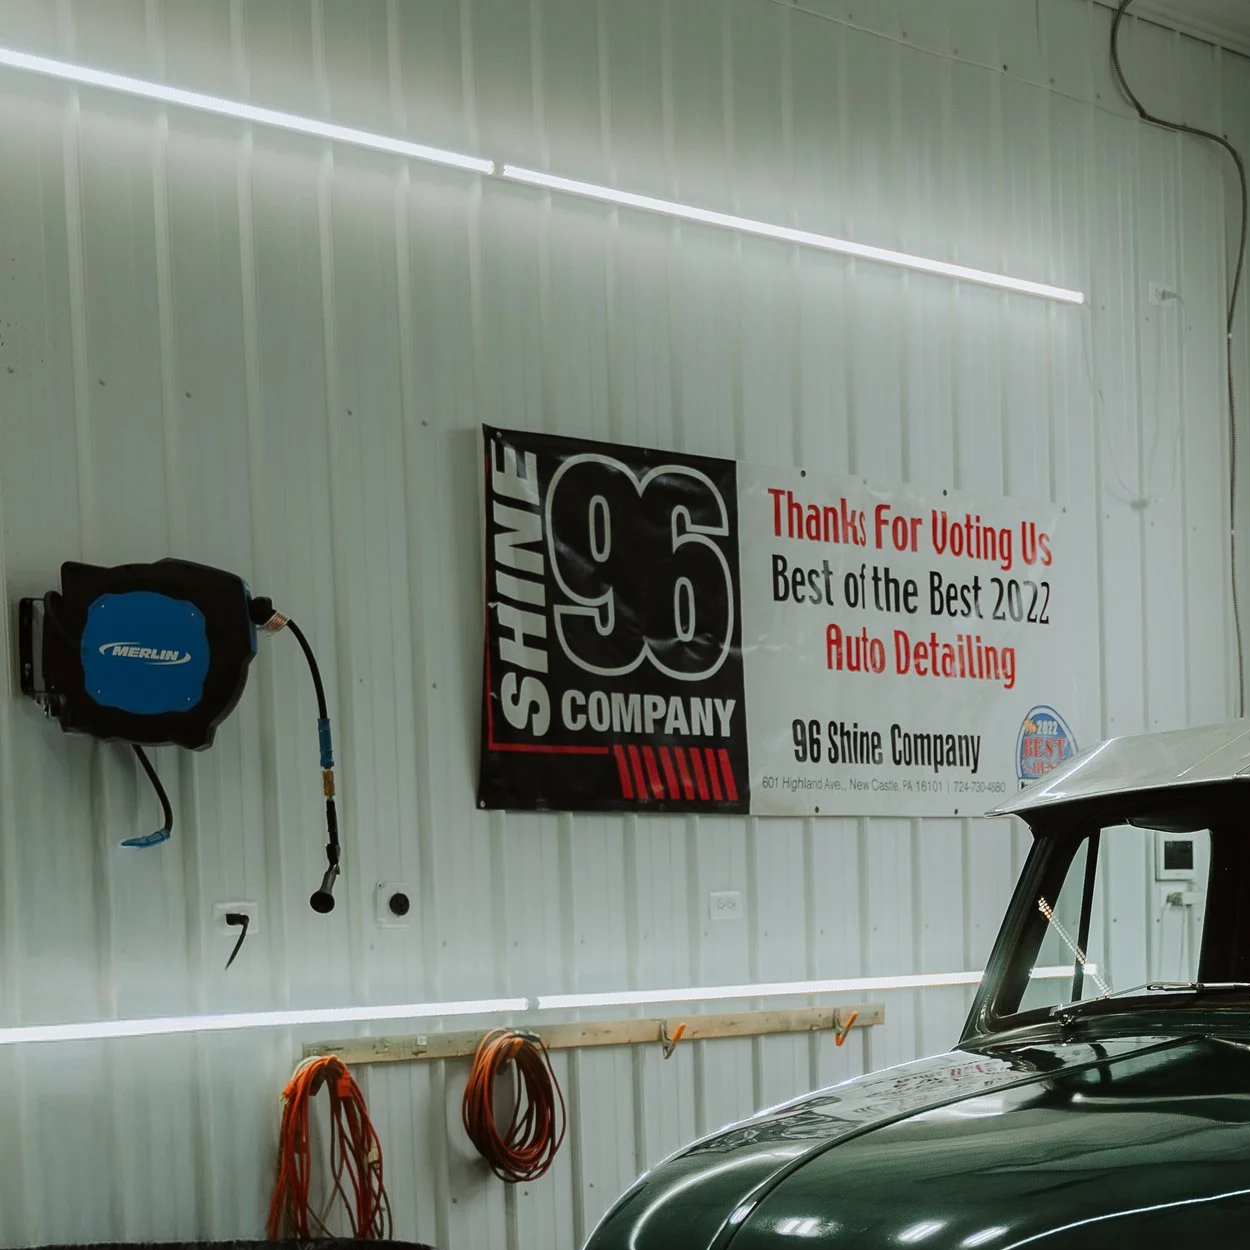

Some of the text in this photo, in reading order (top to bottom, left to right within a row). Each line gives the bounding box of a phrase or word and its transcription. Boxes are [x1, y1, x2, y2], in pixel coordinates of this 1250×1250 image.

[768, 488, 1052, 571] Thanks For Voting Us
[490, 438, 551, 737] SHINE
[546, 452, 734, 681] 96
[772, 554, 1050, 624] Best of the Best 2022
[112, 646, 179, 661] MERLIN
[826, 623, 1016, 689] Auto Detailing
[561, 689, 737, 737] COMPANY
[1037, 720, 1058, 735] 2022
[792, 719, 981, 774] 96 Shine Company
[1024, 737, 1065, 758] BEST
[762, 776, 778, 788] 601
[782, 776, 822, 792] Highland
[849, 778, 870, 791] New
[903, 780, 912, 792] PA
[916, 780, 942, 792] 16101
